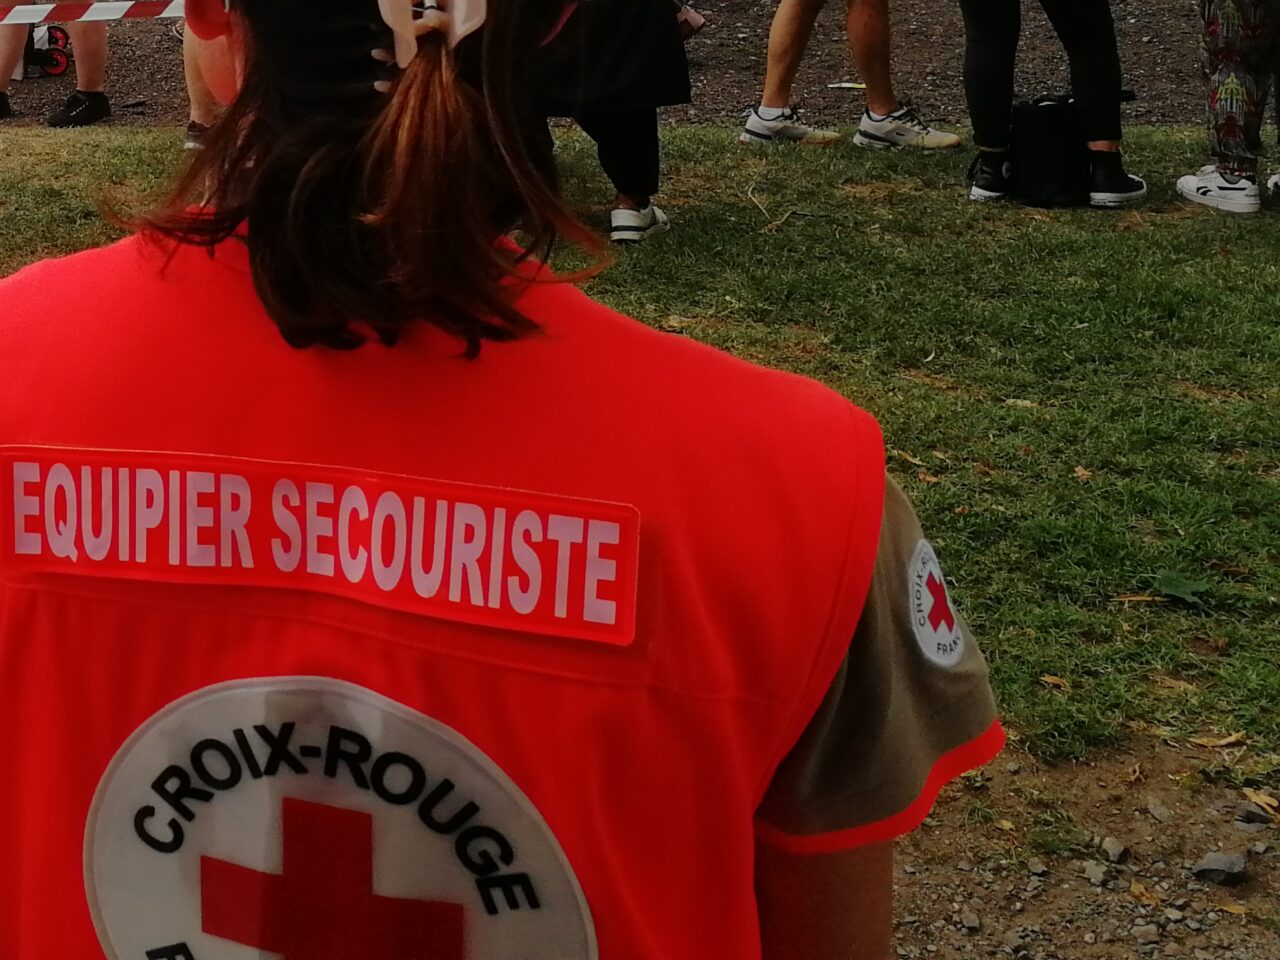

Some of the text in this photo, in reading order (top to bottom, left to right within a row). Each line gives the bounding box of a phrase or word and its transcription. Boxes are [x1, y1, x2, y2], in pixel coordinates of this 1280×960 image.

[12, 461, 620, 626] EQUIPIER SECOURISTE
[133, 721, 541, 917] CROIX-ROUGE
